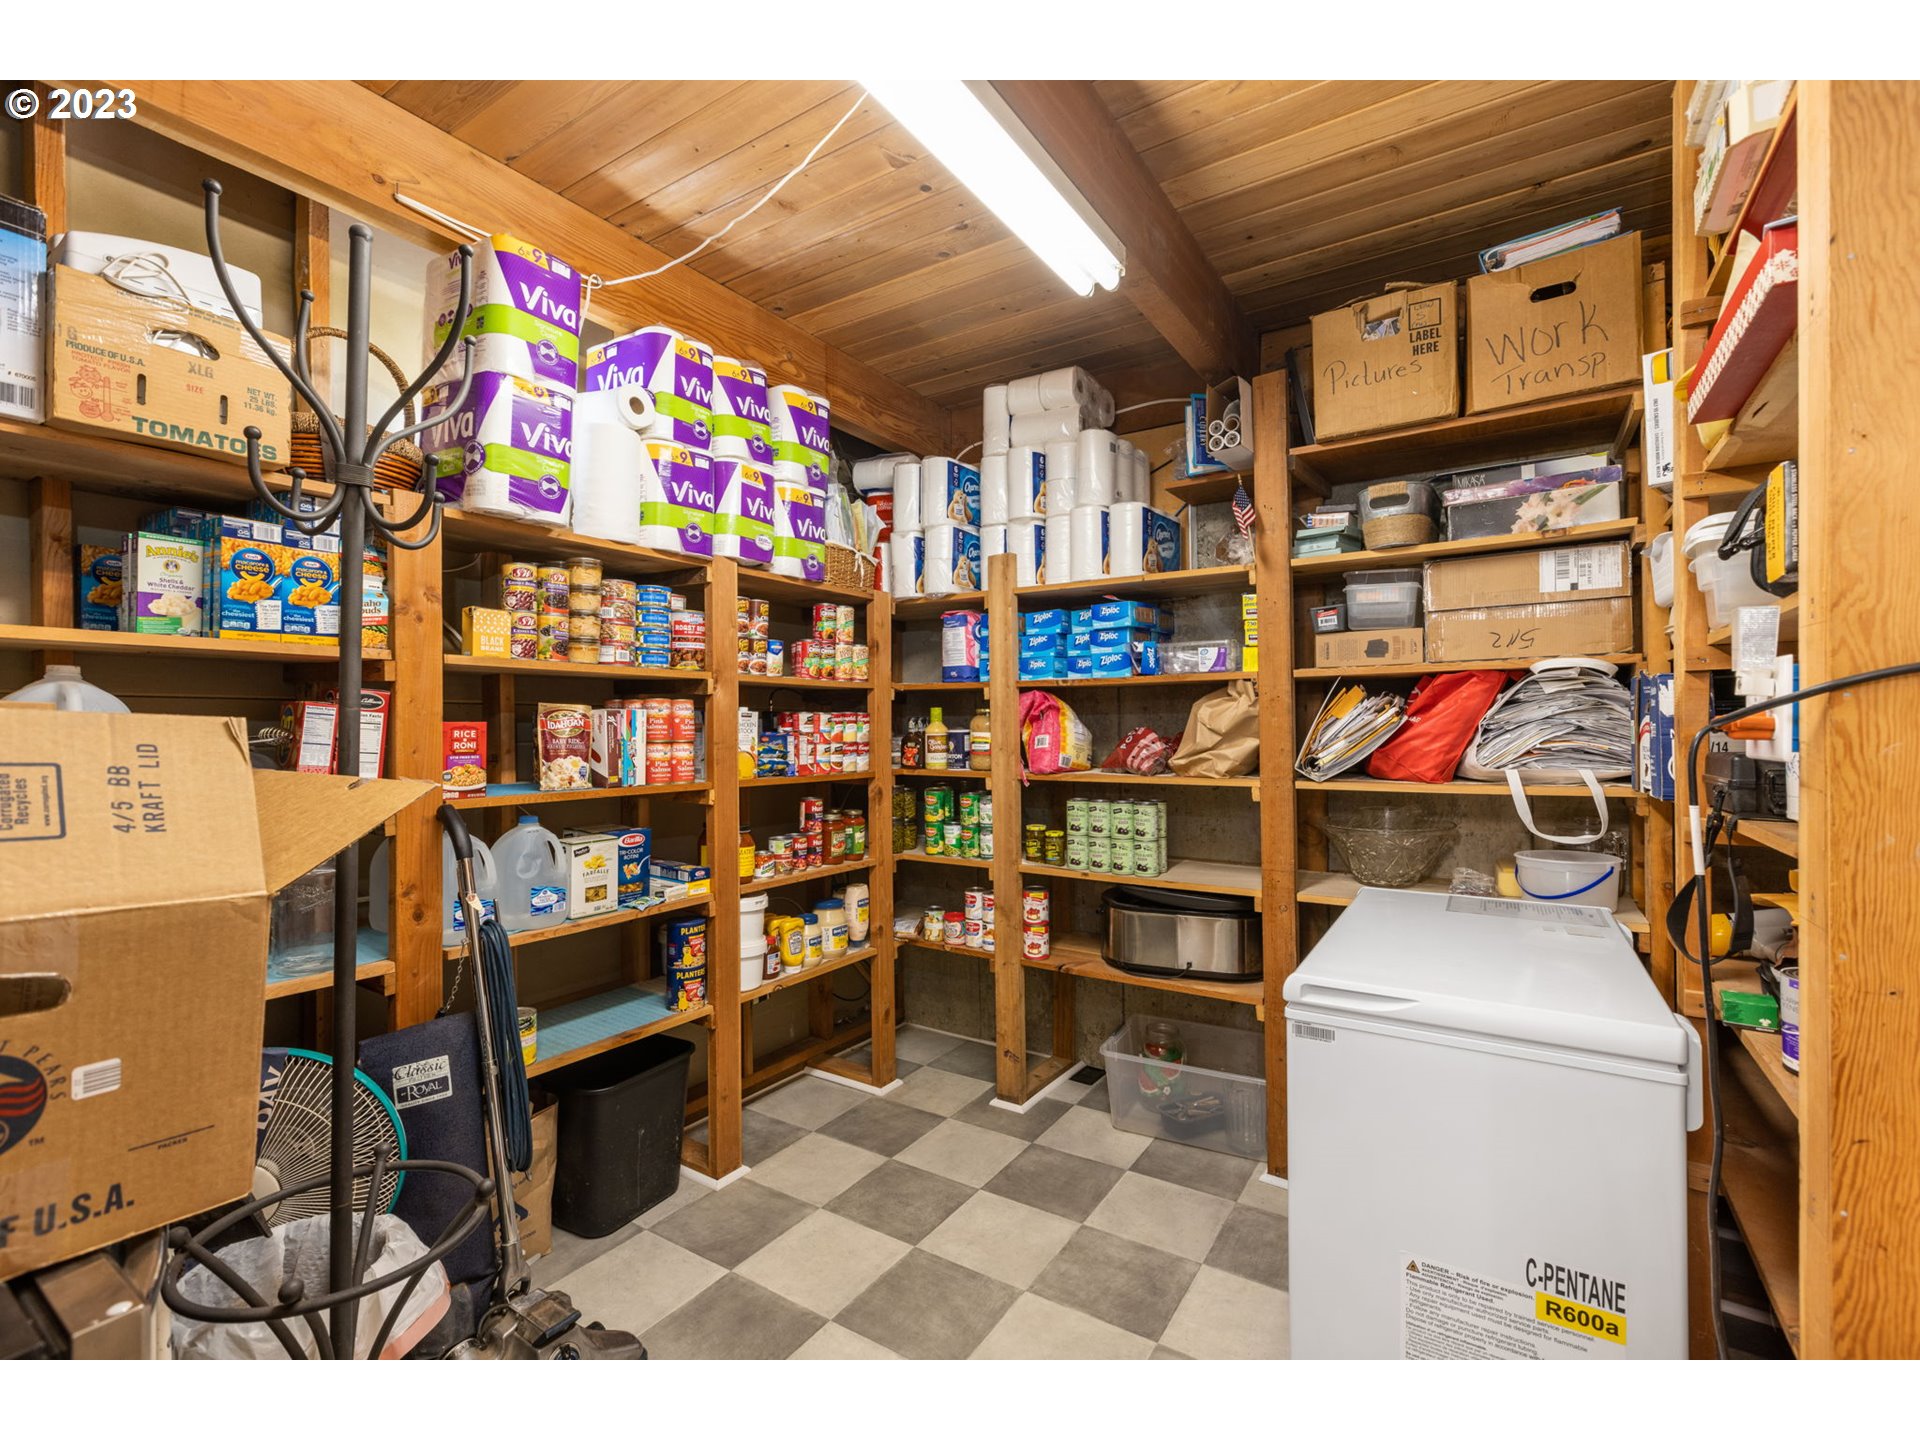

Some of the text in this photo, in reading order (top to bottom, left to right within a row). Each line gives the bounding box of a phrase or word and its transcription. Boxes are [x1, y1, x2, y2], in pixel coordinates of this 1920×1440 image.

[519, 281, 577, 329] Viva
[1410, 328, 1441, 343] LABEL
[1486, 300, 1609, 366] Work
[65, 340, 145, 367] PRODUCE OF U.S.A.
[1412, 341, 1439, 356] HERE
[597, 364, 644, 391] Viva
[1323, 359, 1423, 395] Pictures
[185, 384, 204, 395] SIZE
[247, 386, 260, 397] NET
[131, 416, 278, 461] TOMATOS
[1456, 473, 1487, 487] MIKASA
[145, 545, 199, 563] Annie's
[147, 581, 167, 589] White
[168, 583, 195, 592] Cheddar
[159, 577, 177, 585] Shells
[363, 599, 382, 607] aho
[1033, 611, 1053, 624] Ziploc
[1101, 606, 1120, 616] Ziploc
[283, 615, 314, 623] cheesiest
[480, 635, 504, 645] BLACK
[1029, 635, 1048, 647] Ziploc
[1099, 631, 1118, 641] Ziploc
[1029, 660, 1047, 669] Ziploc
[1100, 653, 1122, 666] Ziploc
[1147, 647, 1155, 669] Ziploc
[547, 718, 584, 730] IDAHOAN
[453, 730, 476, 738] RICE
[136, 743, 168, 834] KRAFT LID
[12, 778, 31, 825] Recycles
[107, 764, 136, 834] 4/5 BB
[624, 834, 643, 844] Barilla
[619, 848, 643, 856] TRI-COLOR
[582, 868, 610, 878] FARFALLE
[22, 1044, 67, 1102] PEARS
[394, 1058, 448, 1080] Classic
[407, 1081, 443, 1101] ROYAL
[157, 1137, 188, 1150] PACKER
[33, 1183, 135, 1236] U.S.A.
[1421, 1261, 1449, 1274] DANGER
[1456, 1272, 1469, 1281] Risk
[1479, 1279, 1490, 1287] fire
[1405, 1271, 1493, 1303] Flammable Refrigerant Used.
[1525, 1257, 1626, 1315] C-PENTANE
[1418, 1282, 1440, 1295] product
[1477, 1301, 1504, 1315] repaired
[1513, 1312, 1535, 1323] trained
[1536, 1319, 1560, 1331] service
[1439, 1301, 1469, 1316] equipment
[1513, 1324, 1541, 1338] designed
[1509, 1317, 1530, 1328] service
[1546, 1299, 1620, 1337] R600a
